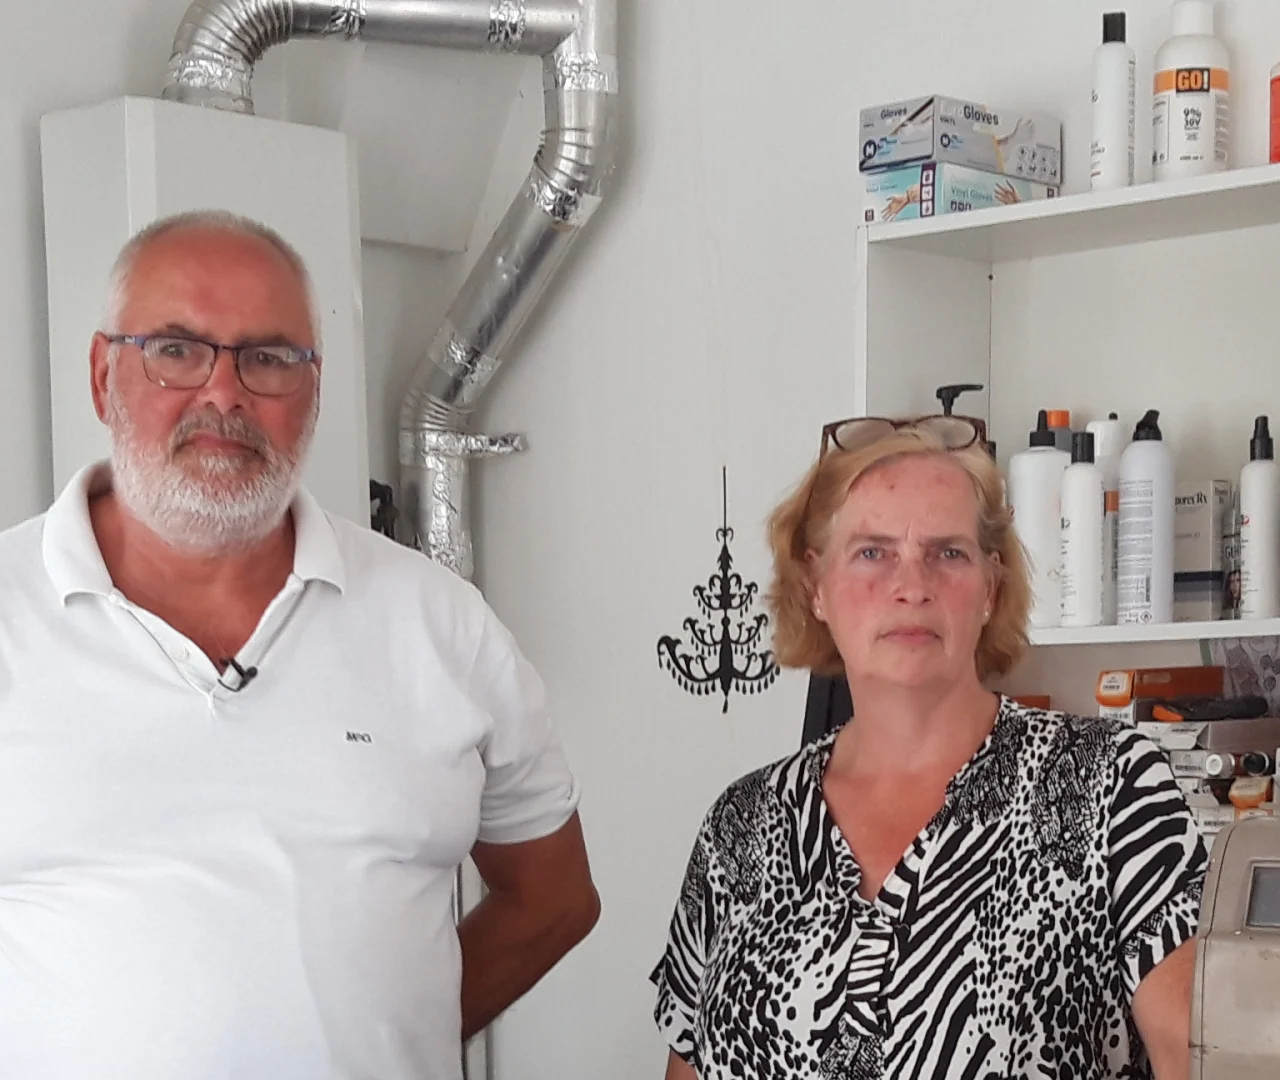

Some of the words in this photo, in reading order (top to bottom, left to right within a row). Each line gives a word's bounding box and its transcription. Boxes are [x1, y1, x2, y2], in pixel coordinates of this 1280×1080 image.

[1177, 70, 1209, 90] GO!
[880, 107, 907, 119] Gloves
[963, 105, 999, 126] Gloves
